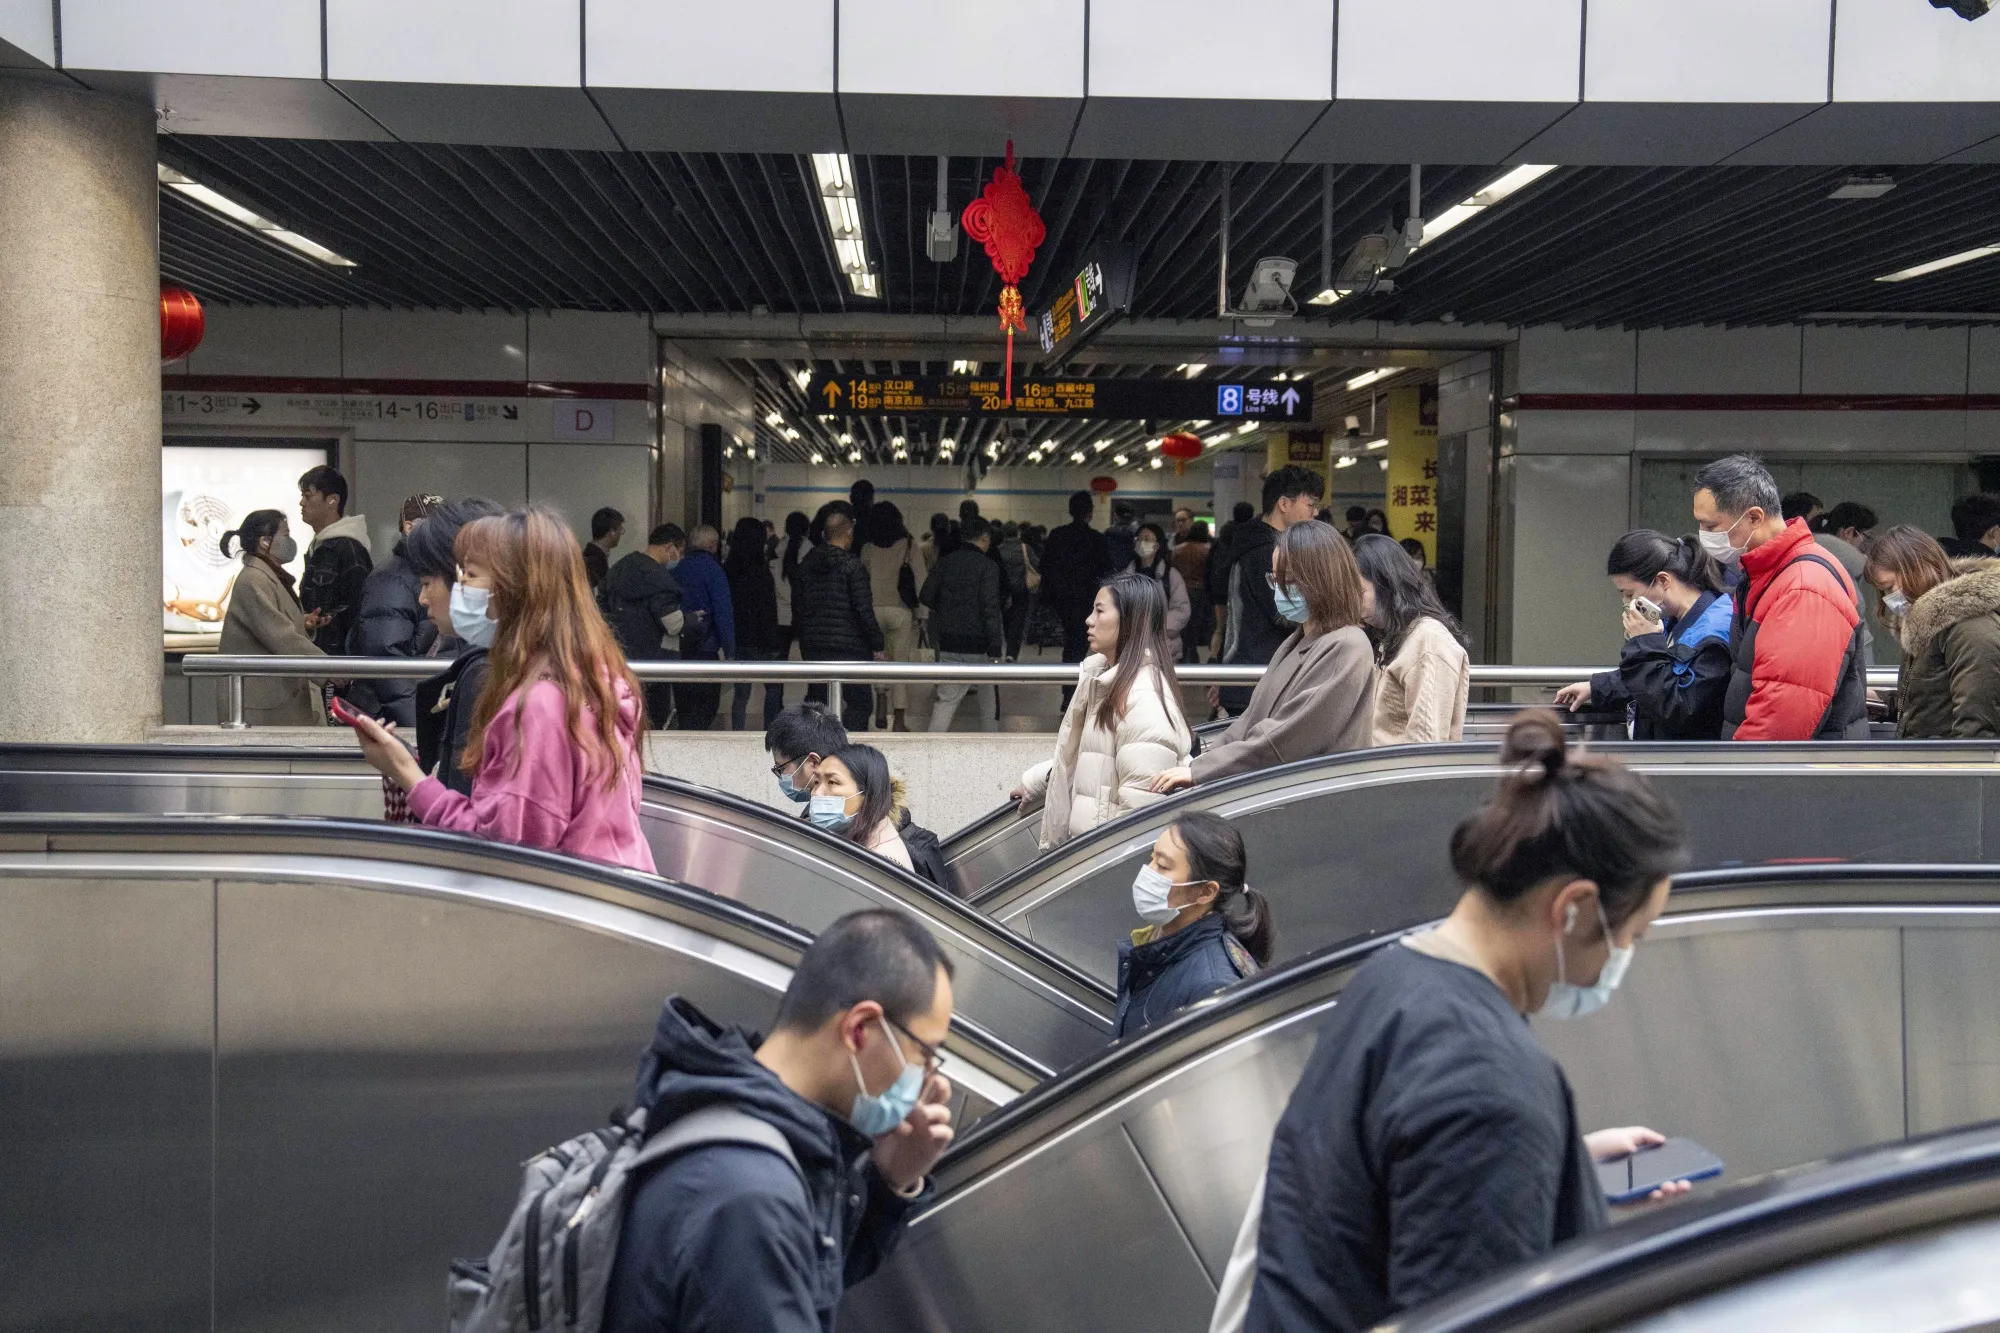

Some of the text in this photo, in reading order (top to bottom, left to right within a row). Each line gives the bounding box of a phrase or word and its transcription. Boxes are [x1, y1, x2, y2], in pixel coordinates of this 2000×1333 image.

[849, 380, 867, 394] 14
[884, 380, 914, 390] 汉口路
[940, 382, 956, 396] 15
[1023, 383, 1040, 397] 16
[849, 394, 867, 409] 19
[982, 396, 1000, 410] 20
[1222, 388, 1279, 412] 8 号线
[575, 409, 594, 431] D
[1392, 485, 1437, 507] 湘菜
[1415, 511, 1436, 533] 来
